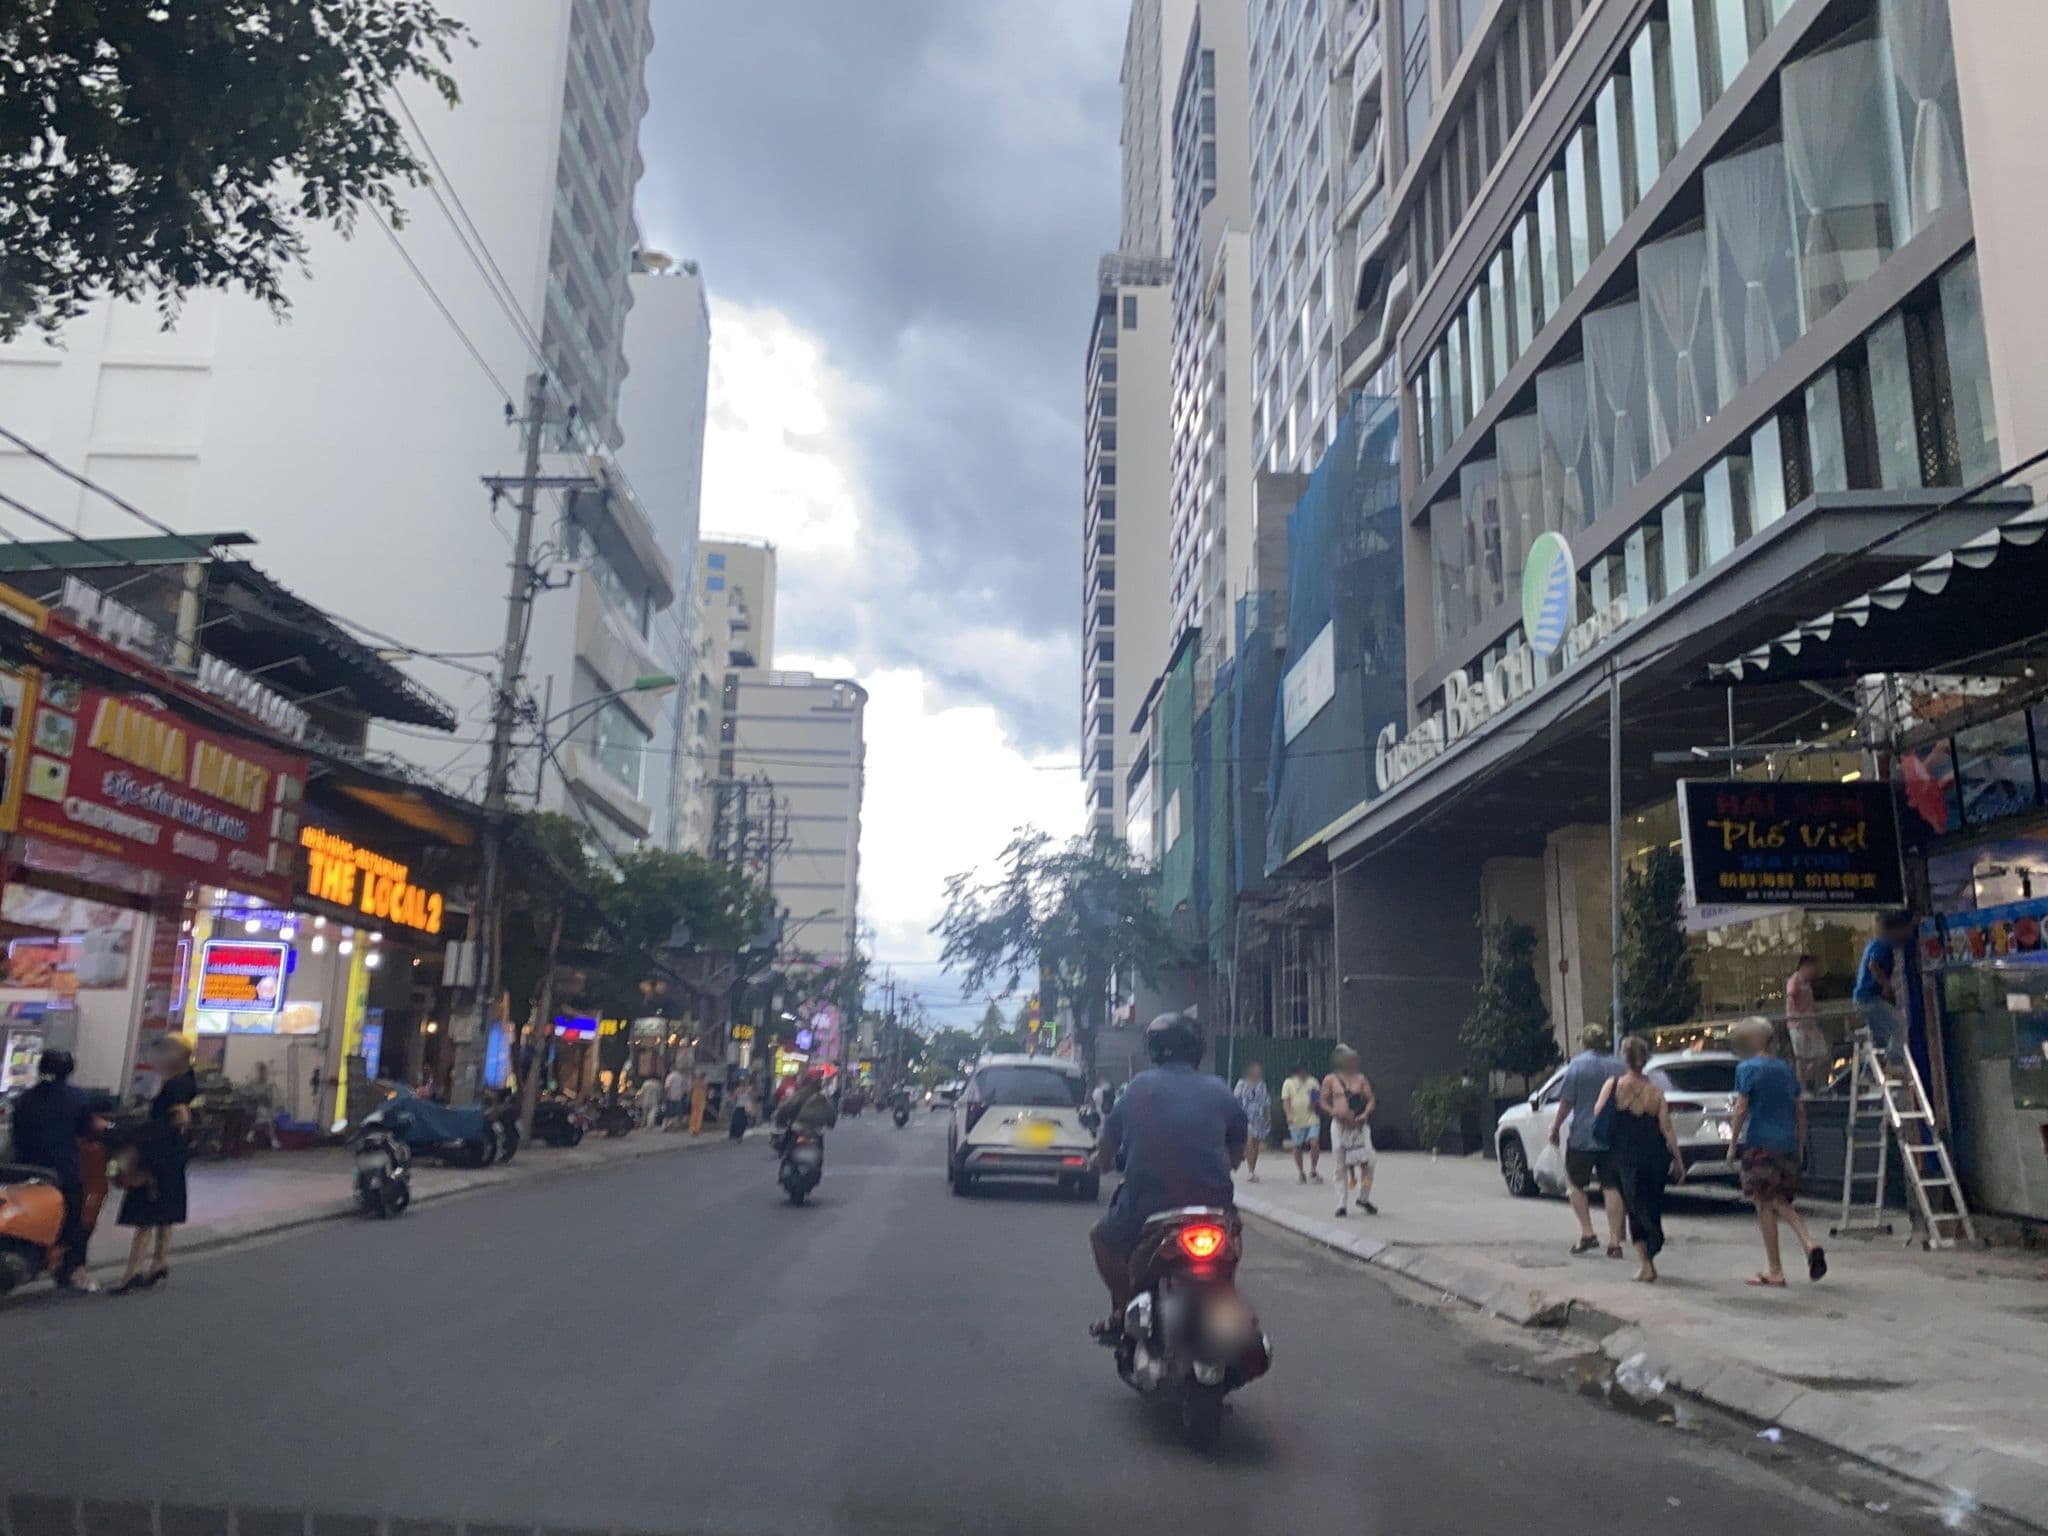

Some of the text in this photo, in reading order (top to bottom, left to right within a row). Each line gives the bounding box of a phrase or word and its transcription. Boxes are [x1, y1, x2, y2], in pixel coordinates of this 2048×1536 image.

[1375, 710, 1446, 793] GREEN
[1443, 642, 1536, 748] BEACH
[189, 739, 271, 814] MART
[1707, 817, 1791, 851] Phố
[309, 847, 356, 907] THE
[360, 869, 428, 930] LOCAL
[425, 892, 443, 934] 2
